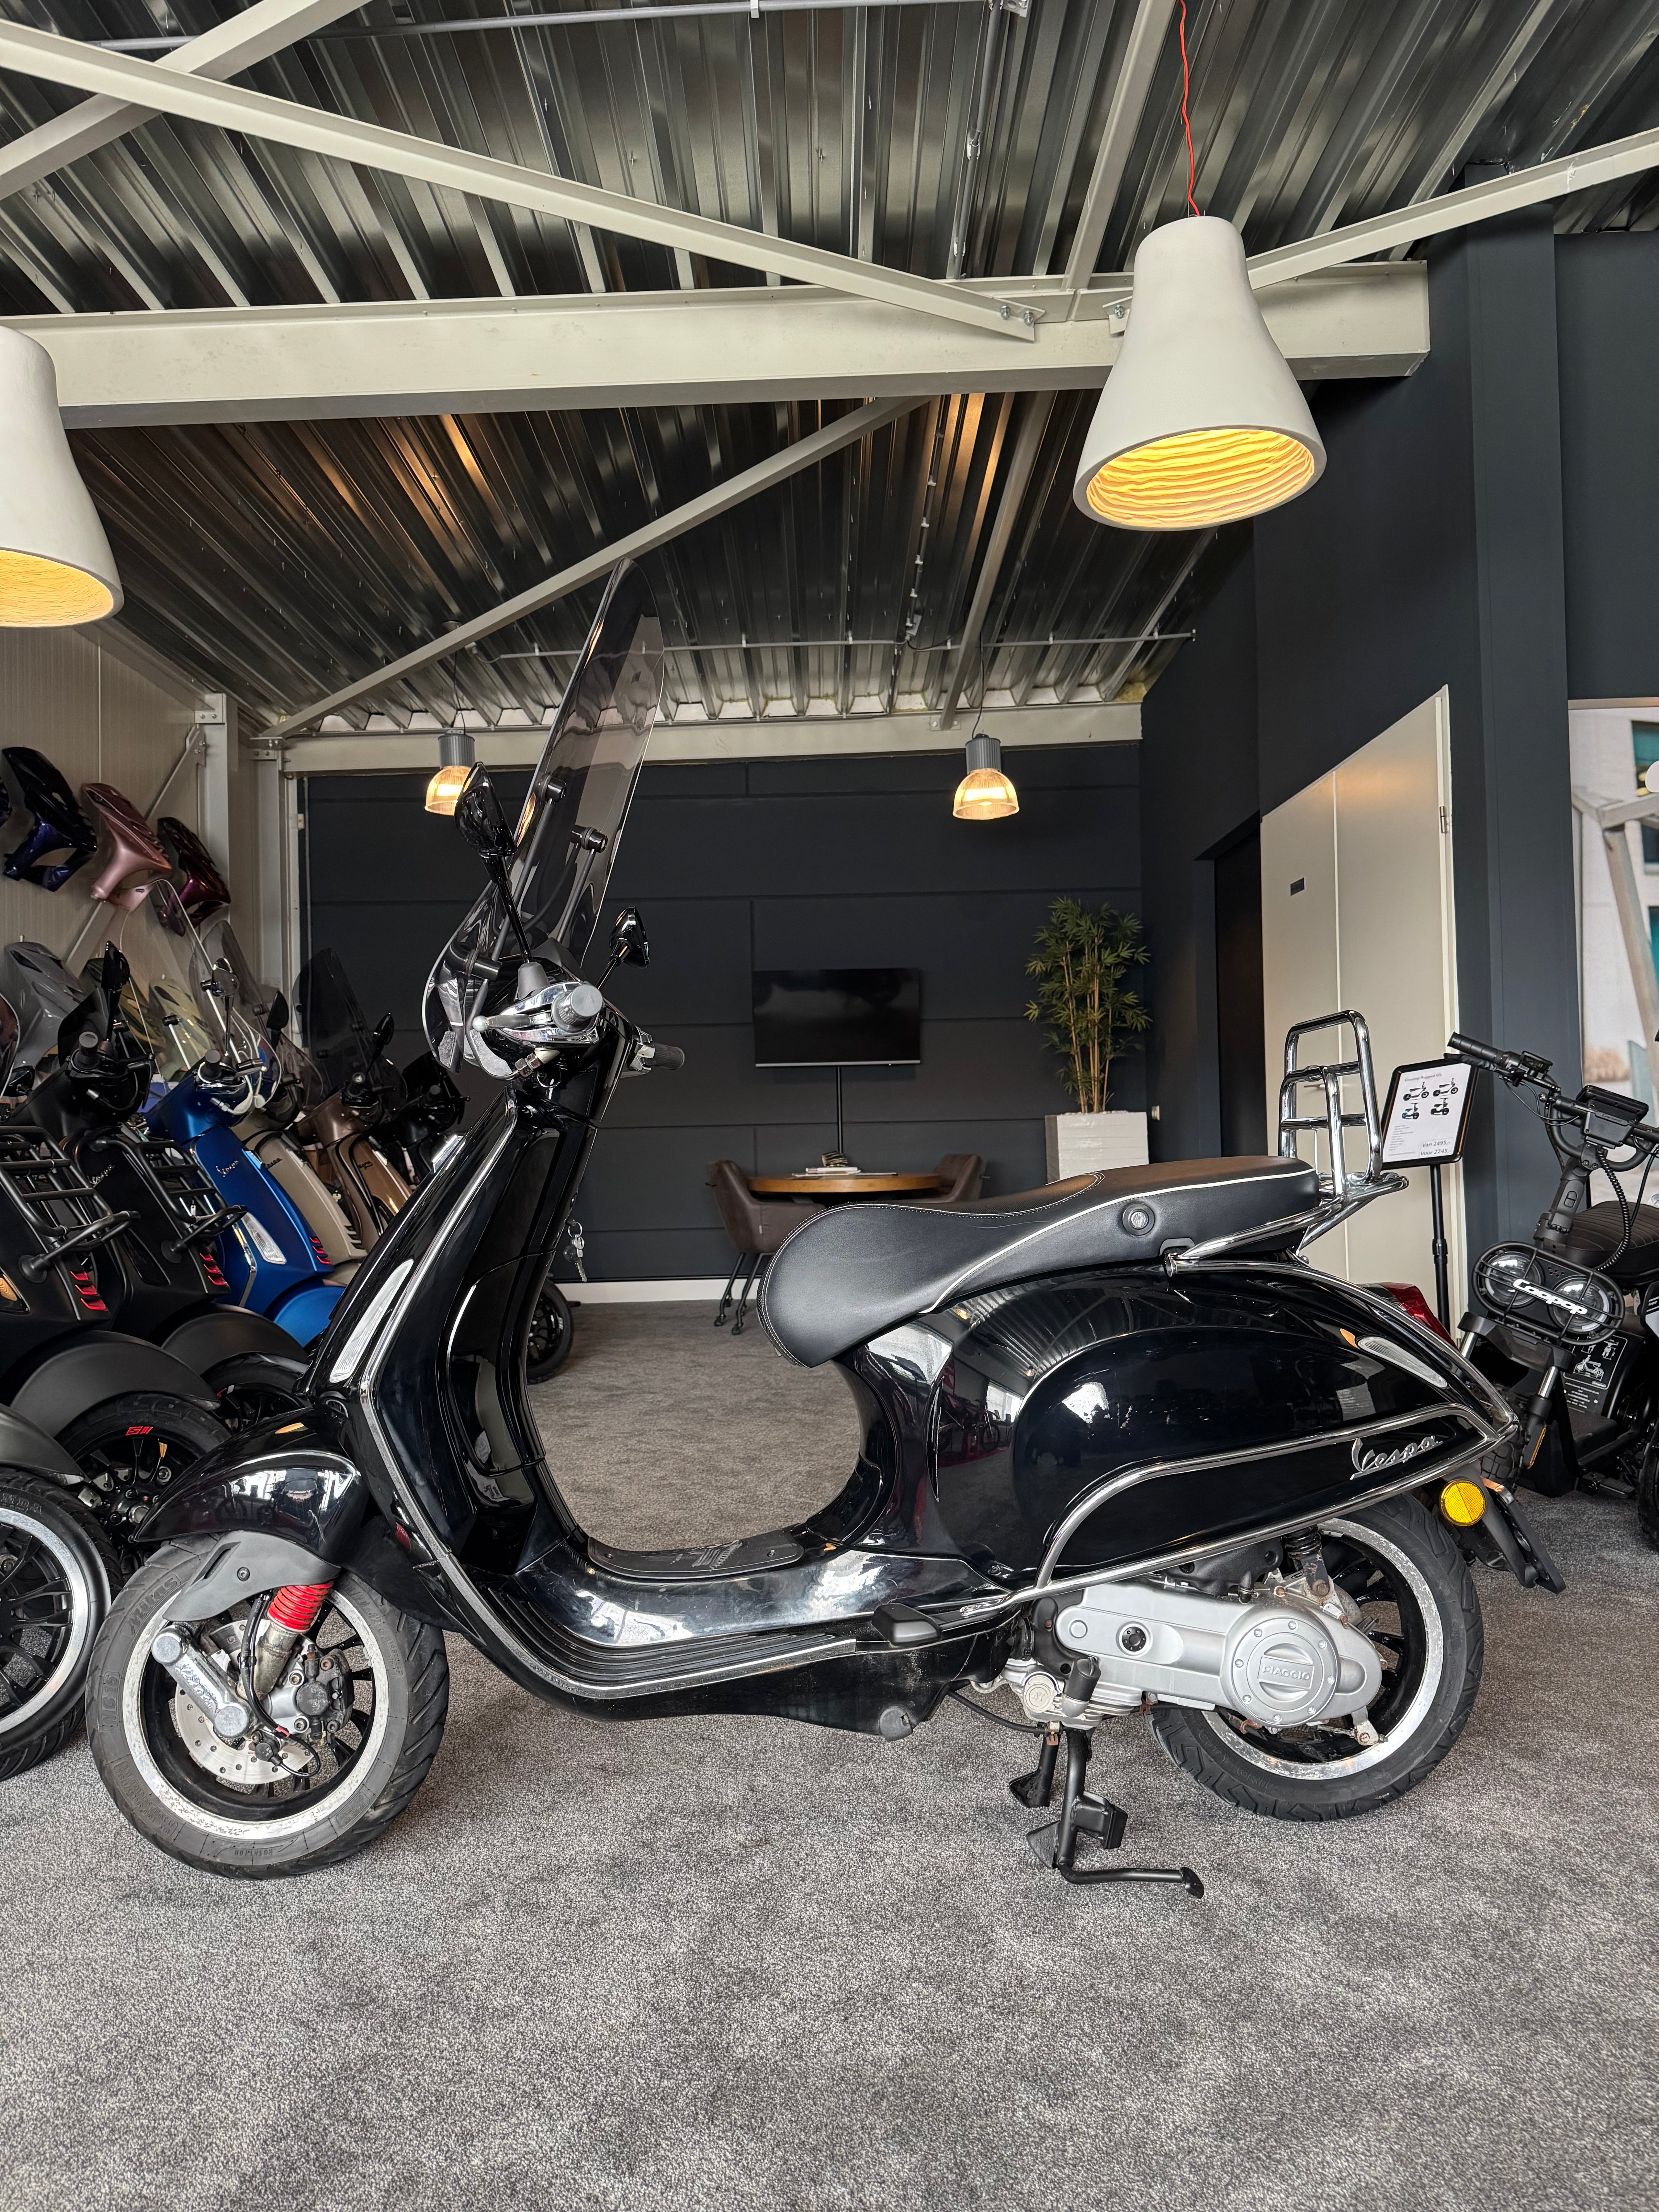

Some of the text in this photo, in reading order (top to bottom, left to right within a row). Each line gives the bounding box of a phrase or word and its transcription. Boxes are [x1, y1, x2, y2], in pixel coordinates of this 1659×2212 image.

[1513, 1279, 1588, 1315] Coopop
[1350, 1437, 1443, 1480] Vespa
[1262, 1666, 1310, 1680] PIAGGIO
[1199, 1730, 1229, 1762] CITY
[234, 1848, 273, 1856] ROTATION
